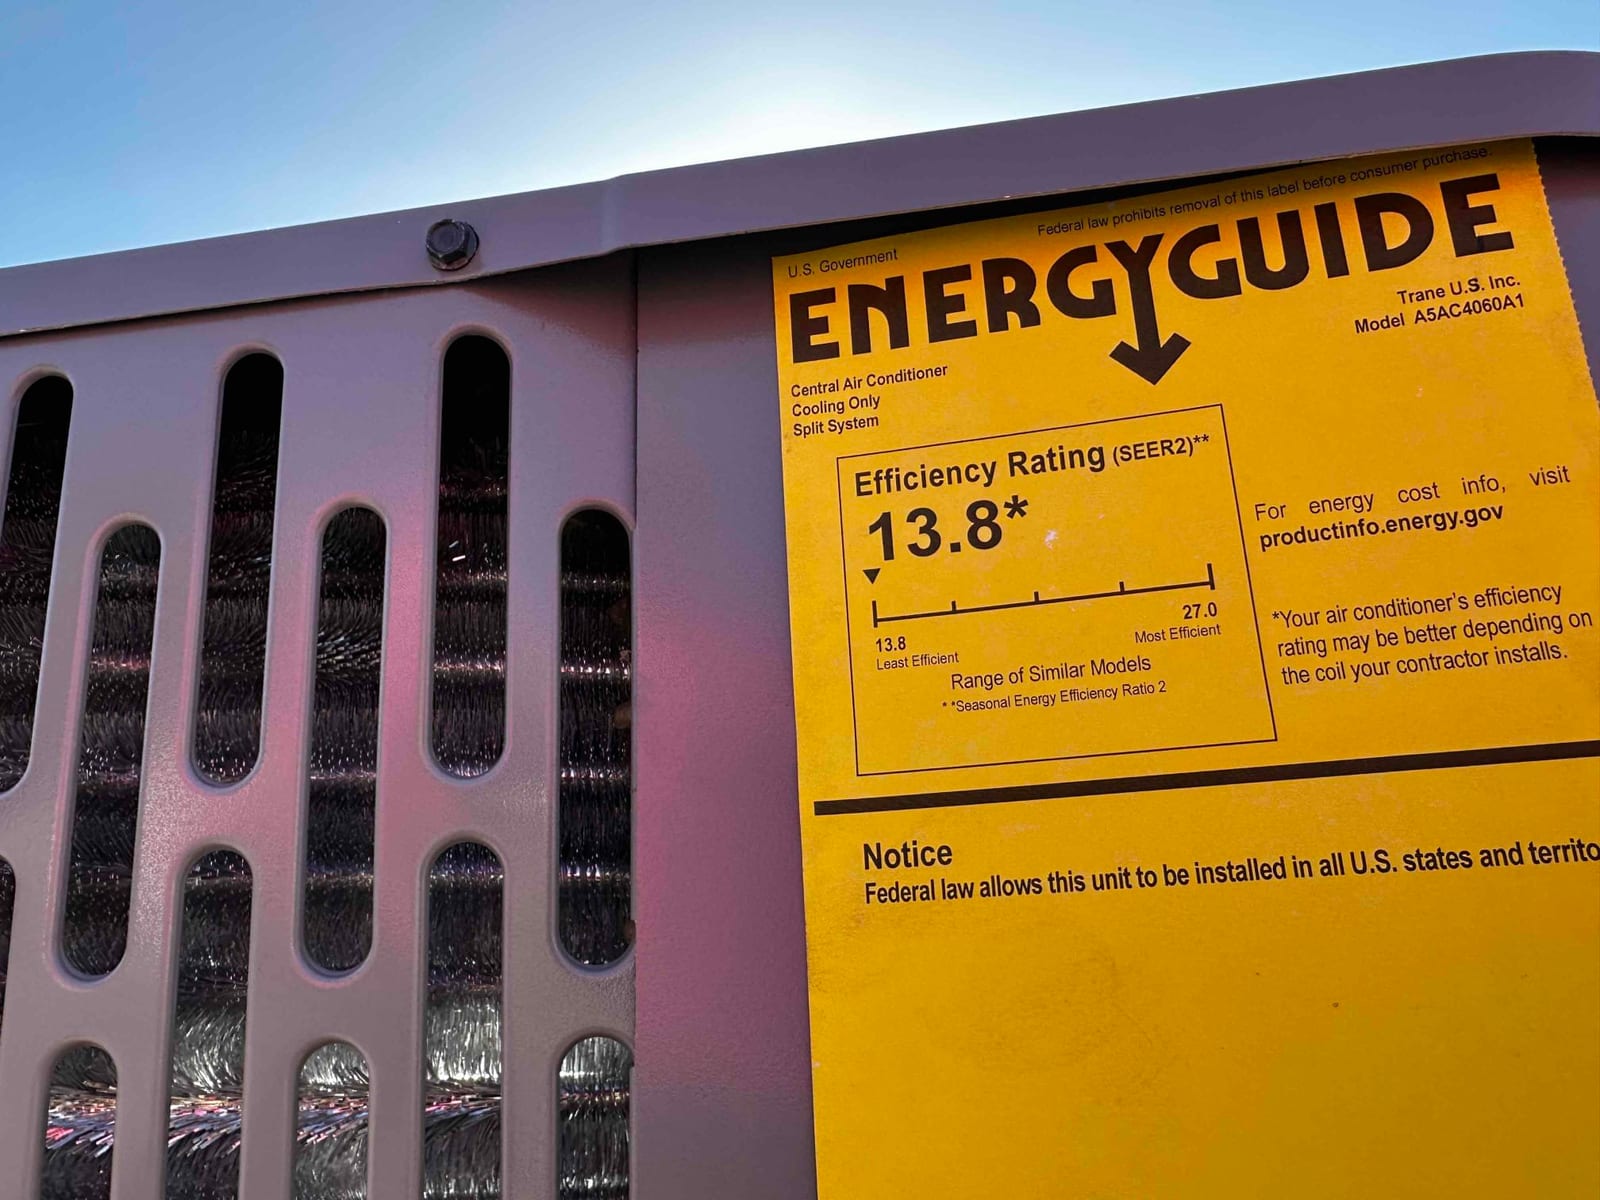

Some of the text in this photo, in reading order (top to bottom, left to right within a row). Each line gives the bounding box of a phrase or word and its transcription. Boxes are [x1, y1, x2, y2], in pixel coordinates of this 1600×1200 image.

[1038, 148, 1492, 236] Federal law prohibits removal of this label before consumer purchase.
[788, 249, 898, 278] U.S. Government
[1397, 273, 1521, 304] Trane U.S. Inc.
[1355, 294, 1524, 334] Model A5AC4060A1
[791, 363, 948, 398] Central Air Conditioner
[792, 394, 881, 417] Cooling Only
[793, 415, 879, 438] Split System
[855, 456, 997, 496] Efficiency
[1008, 445, 1105, 477] Rating
[1255, 465, 1571, 521] For energy cost info, visit
[1259, 504, 1504, 552] productinfo.energy.gov
[1183, 602, 1217, 620] 27.0
[1326, 605, 1347, 624] air
[1353, 593, 1469, 622] conditioner's
[1474, 584, 1562, 608] efficiency
[875, 636, 906, 653] 13.8
[1135, 624, 1222, 644] Most Efficient
[1277, 610, 1593, 658] rating may be better depending on
[876, 652, 959, 671] Least Efficient
[951, 656, 1151, 692] Range of Similar Models
[1281, 642, 1568, 686] the coil your contractor installs.
[1015, 692, 1056, 708] Energy
[1060, 686, 1118, 704] Efficiency
[1122, 682, 1155, 696] Ratio
[1158, 681, 1166, 693] 2
[863, 840, 952, 870] Notice
[865, 838, 1600, 904] Federal law allows this unit to be installed in all U.S. states and territo
